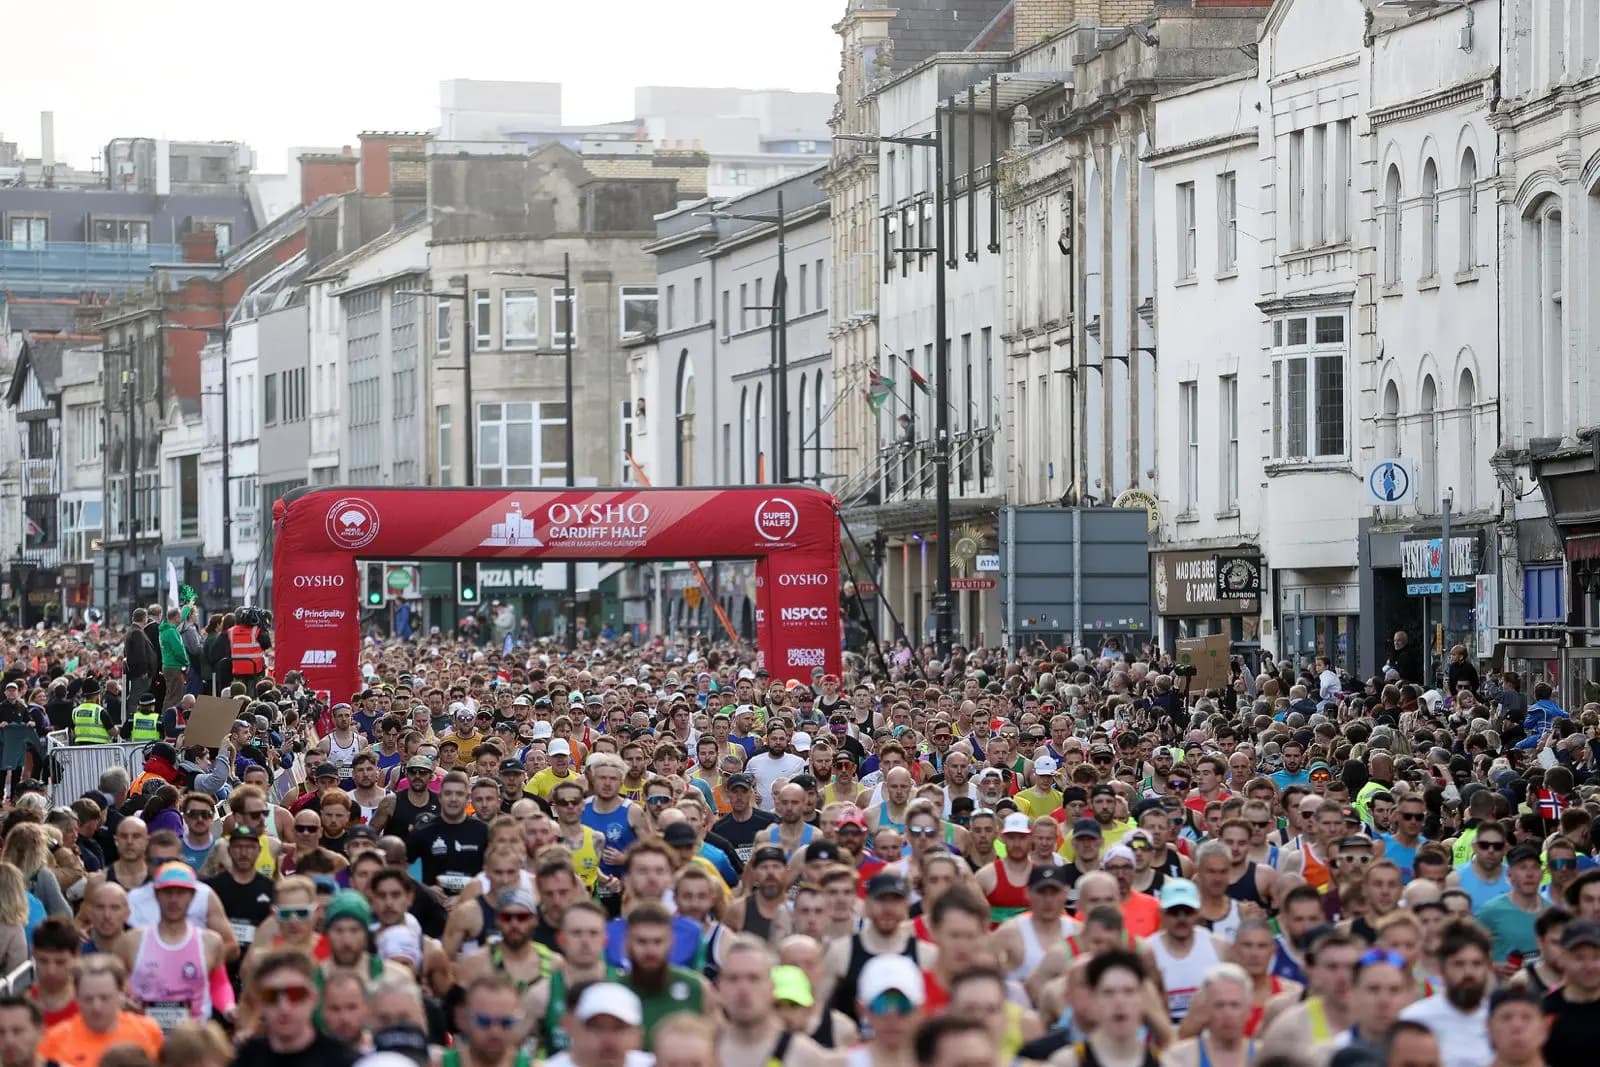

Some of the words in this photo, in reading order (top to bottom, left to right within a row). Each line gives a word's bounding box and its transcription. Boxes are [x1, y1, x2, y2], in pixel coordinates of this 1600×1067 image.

[1130, 491, 1157, 510] BREWERY
[1151, 511, 1158, 521] CO
[548, 503, 650, 525] OYSHO
[762, 519, 791, 527] HALFS
[549, 526, 609, 539] CARDIFF
[611, 526, 647, 538] HALF
[1175, 560, 1189, 580] MAD
[1190, 560, 1201, 579] DOG
[293, 575, 344, 587] OYSHO
[480, 570, 512, 587] PIZZA
[778, 573, 828, 586] OYSHO
[1186, 581, 1192, 602] &
[304, 609, 345, 619] Principality
[781, 607, 828, 620] NSPCC
[300, 650, 337, 664] ABP
[787, 648, 825, 658] BRECON
[787, 657, 825, 666] CARREG
